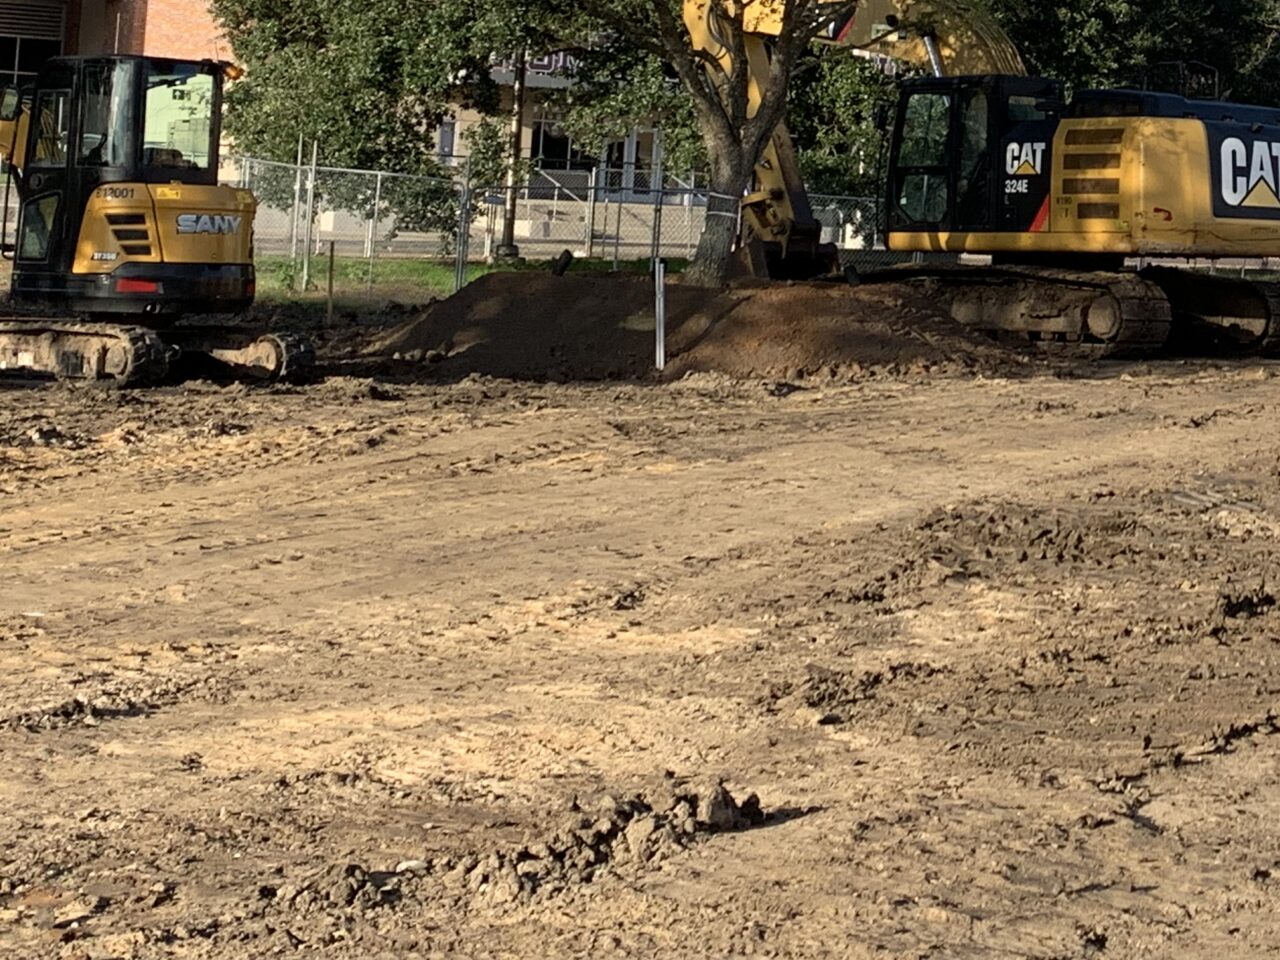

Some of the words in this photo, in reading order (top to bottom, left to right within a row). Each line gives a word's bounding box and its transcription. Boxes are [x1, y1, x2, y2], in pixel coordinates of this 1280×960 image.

[1005, 141, 1046, 175] CAT
[1004, 179, 1029, 193] 324E
[177, 214, 242, 234] SANY
